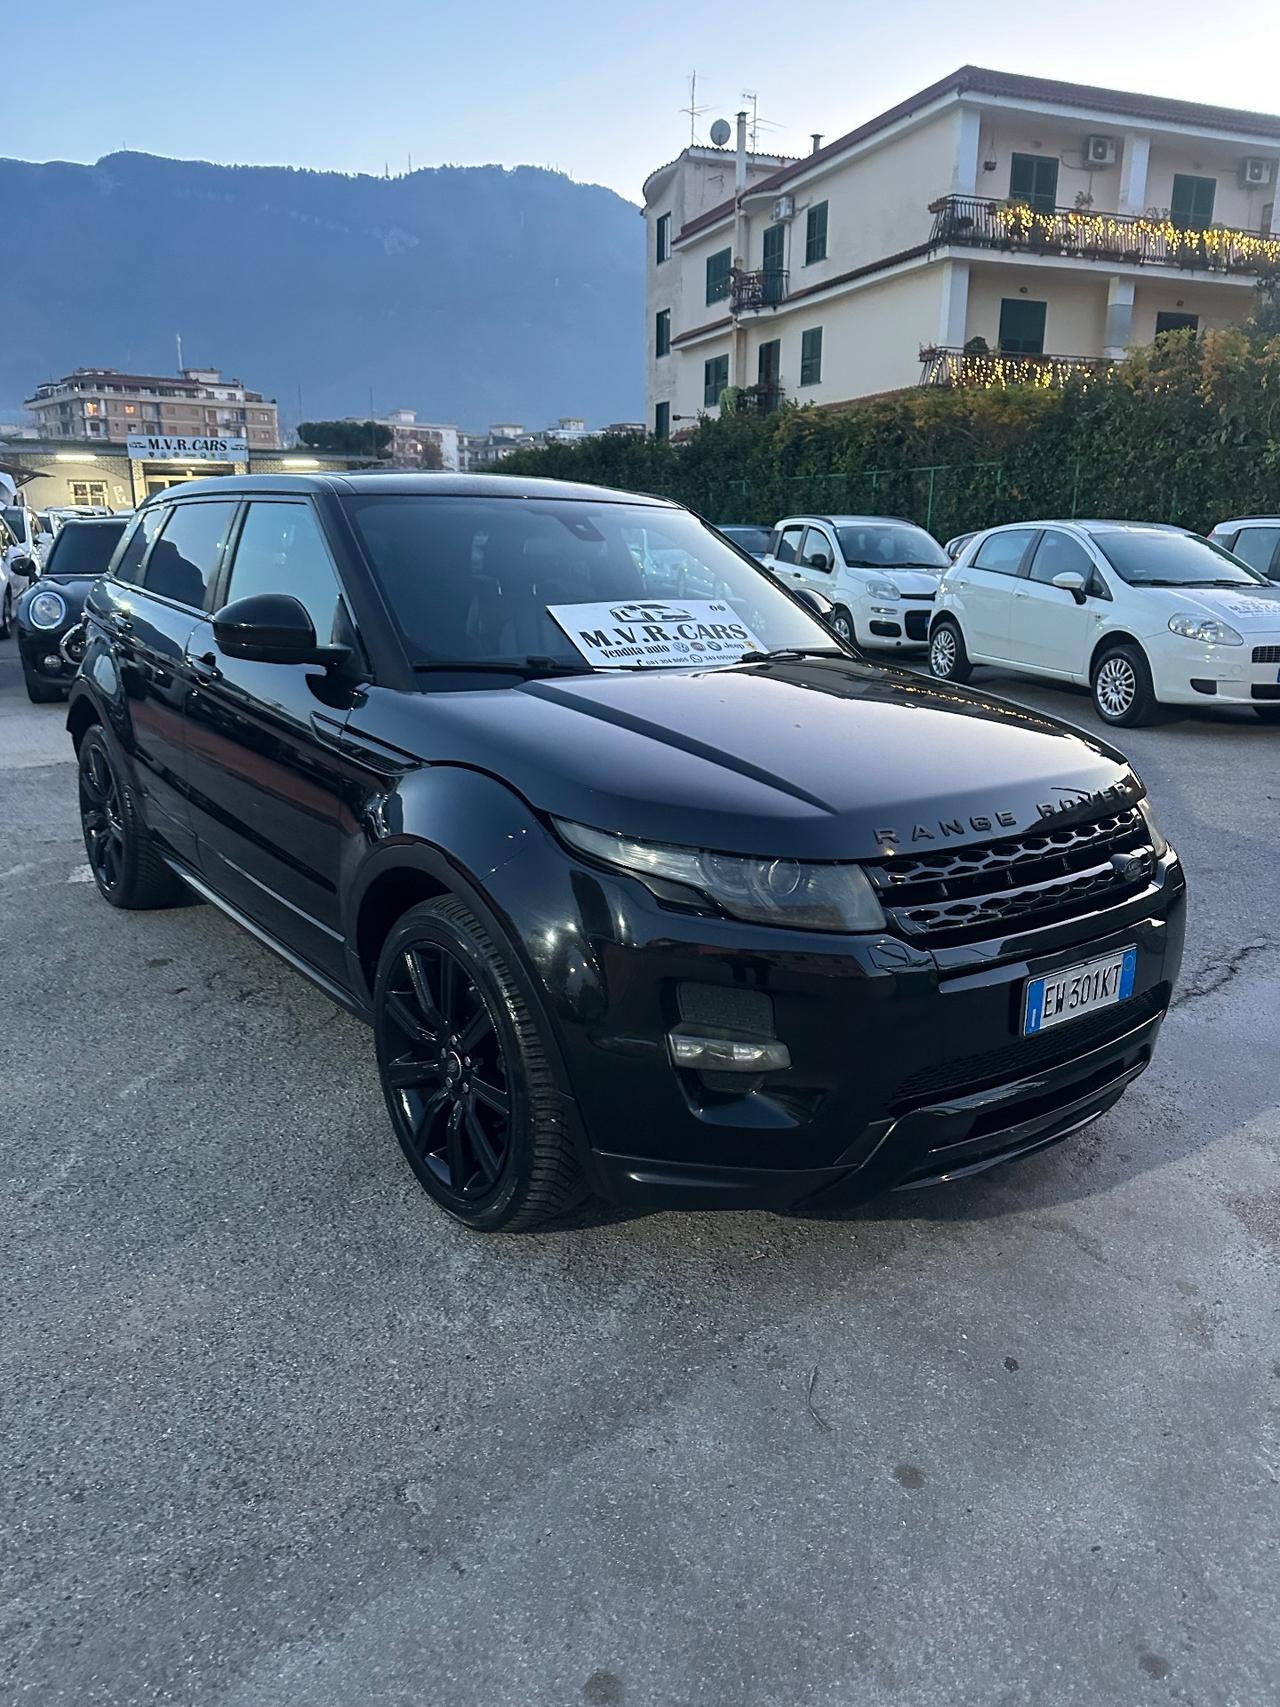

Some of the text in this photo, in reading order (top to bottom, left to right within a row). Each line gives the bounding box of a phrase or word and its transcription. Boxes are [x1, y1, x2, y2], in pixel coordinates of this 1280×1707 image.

[600, 644, 670, 658] Vendita auto
[873, 782, 1132, 845] RANGE ROVER
